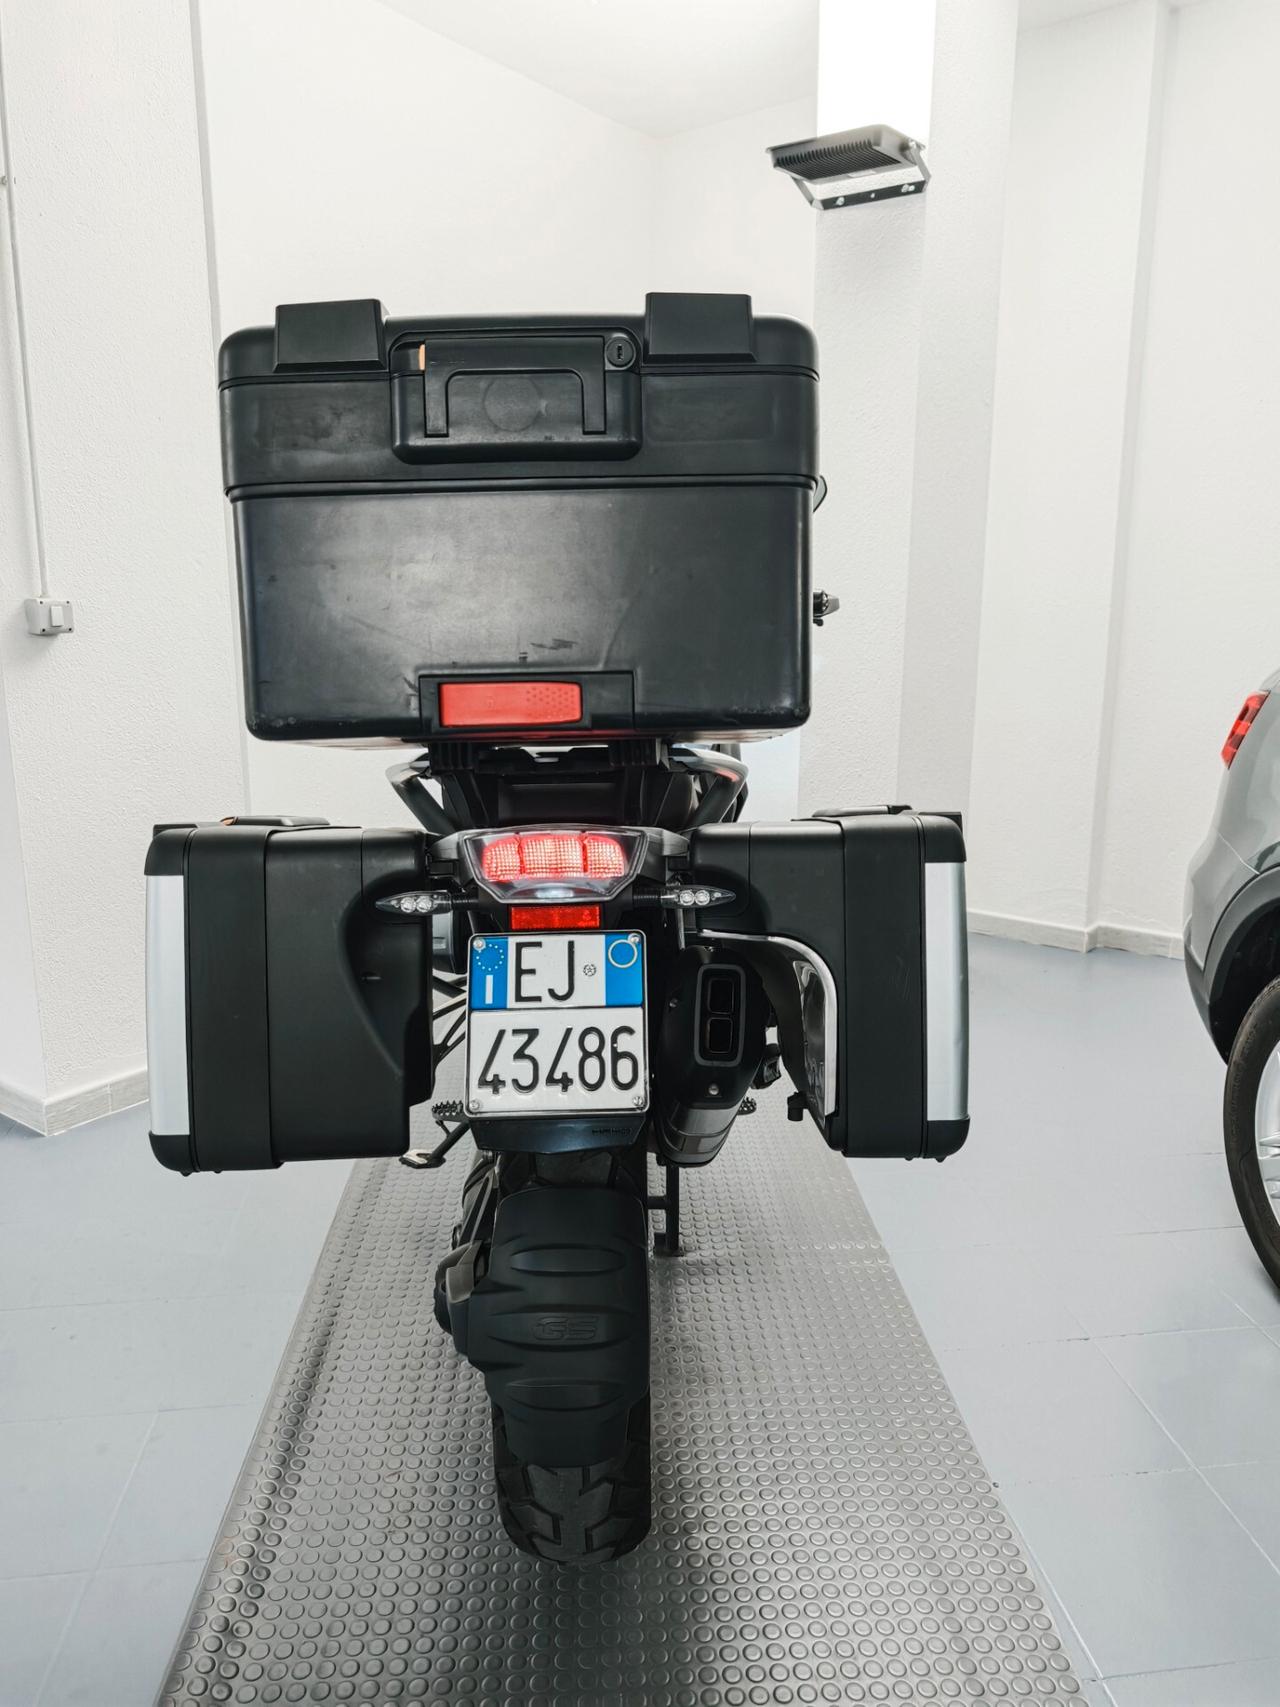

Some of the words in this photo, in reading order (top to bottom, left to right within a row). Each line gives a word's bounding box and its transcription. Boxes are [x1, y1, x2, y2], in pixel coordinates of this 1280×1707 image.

[514, 940, 575, 1003] EJ
[477, 1025, 639, 1095] 43486
[532, 1316, 598, 1341] GS
